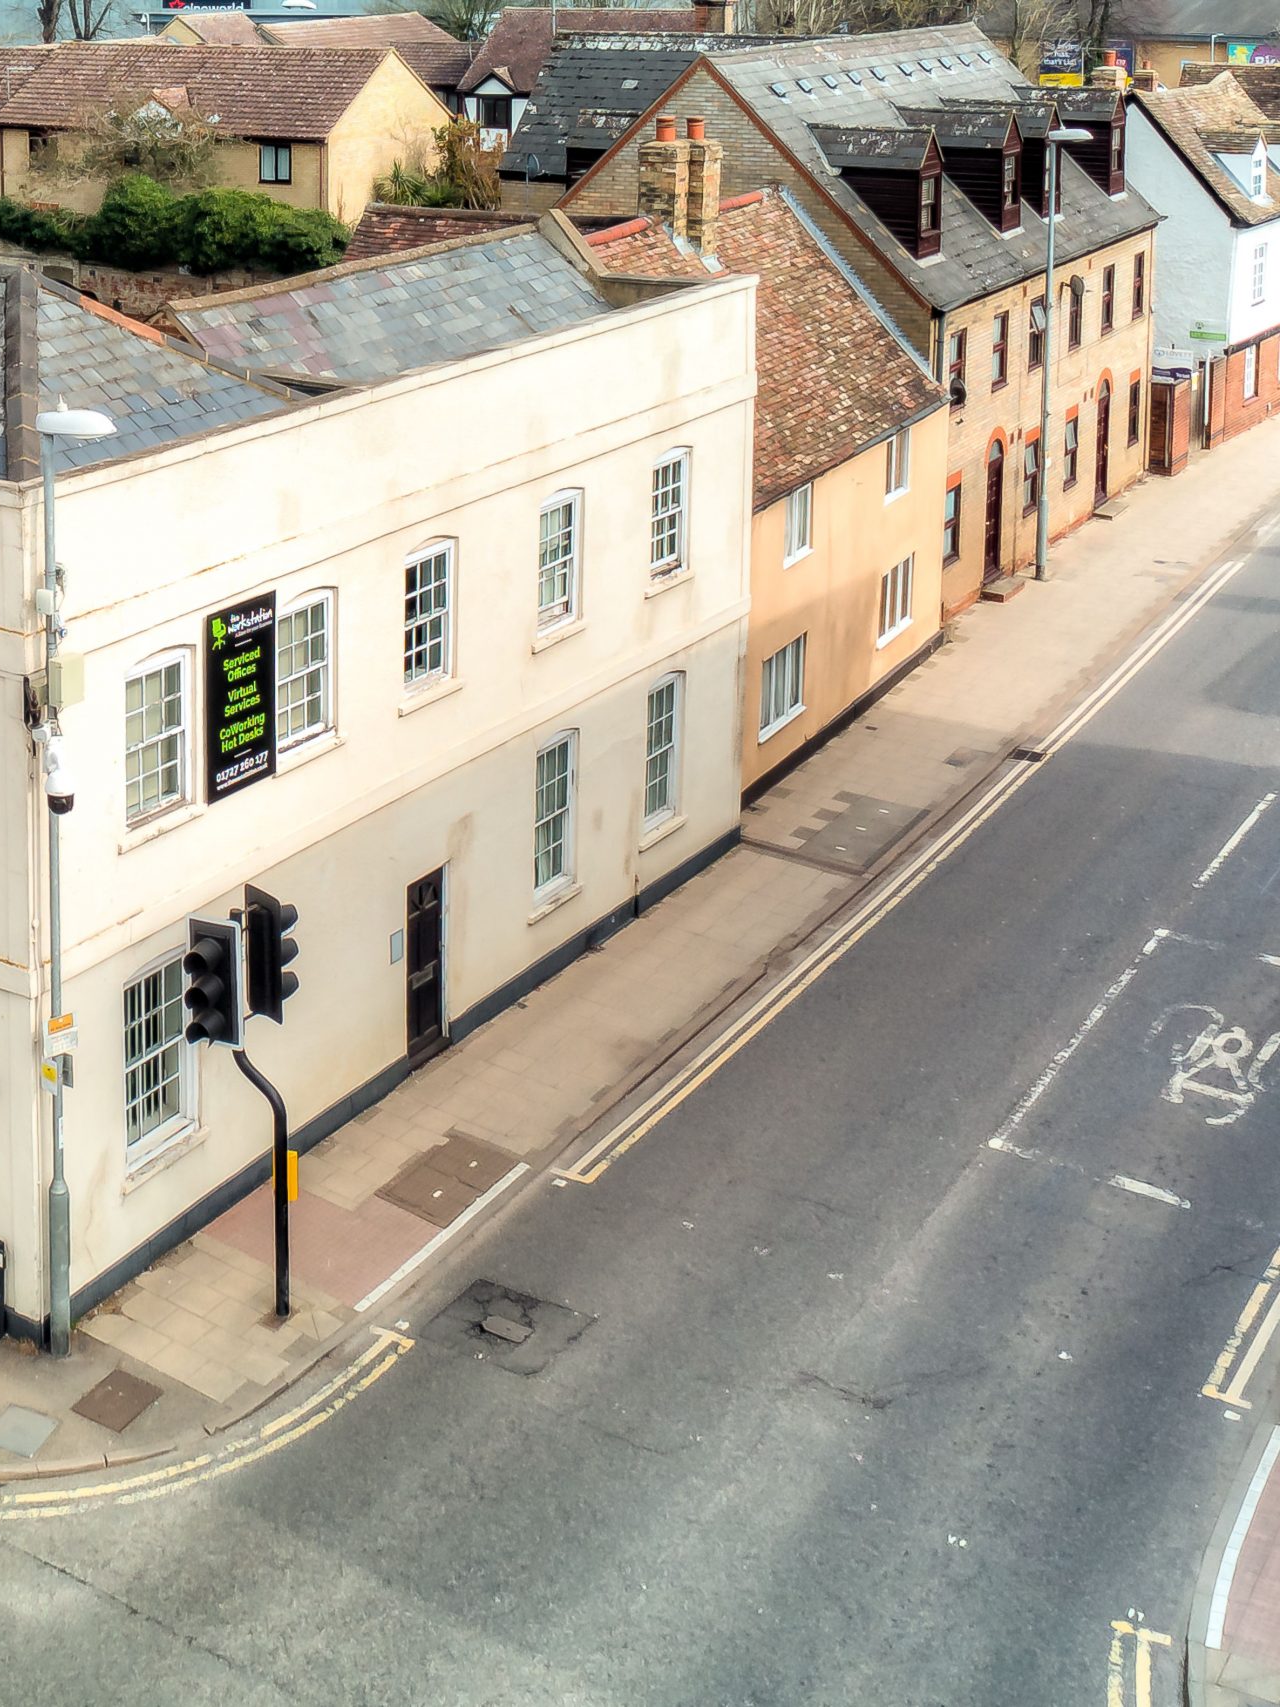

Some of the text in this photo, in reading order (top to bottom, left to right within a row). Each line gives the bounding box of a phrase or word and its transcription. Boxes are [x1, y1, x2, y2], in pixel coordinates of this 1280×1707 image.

[227, 607, 273, 634] workstation
[223, 646, 261, 671] Serviced
[227, 663, 257, 681] Offices
[227, 680, 257, 702] Virtual
[224, 694, 261, 717] Services
[219, 713, 266, 740] CoWorking
[221, 726, 264, 753] Hot Desks
[216, 764, 241, 783] 01727
[255, 750, 269, 765] 177
